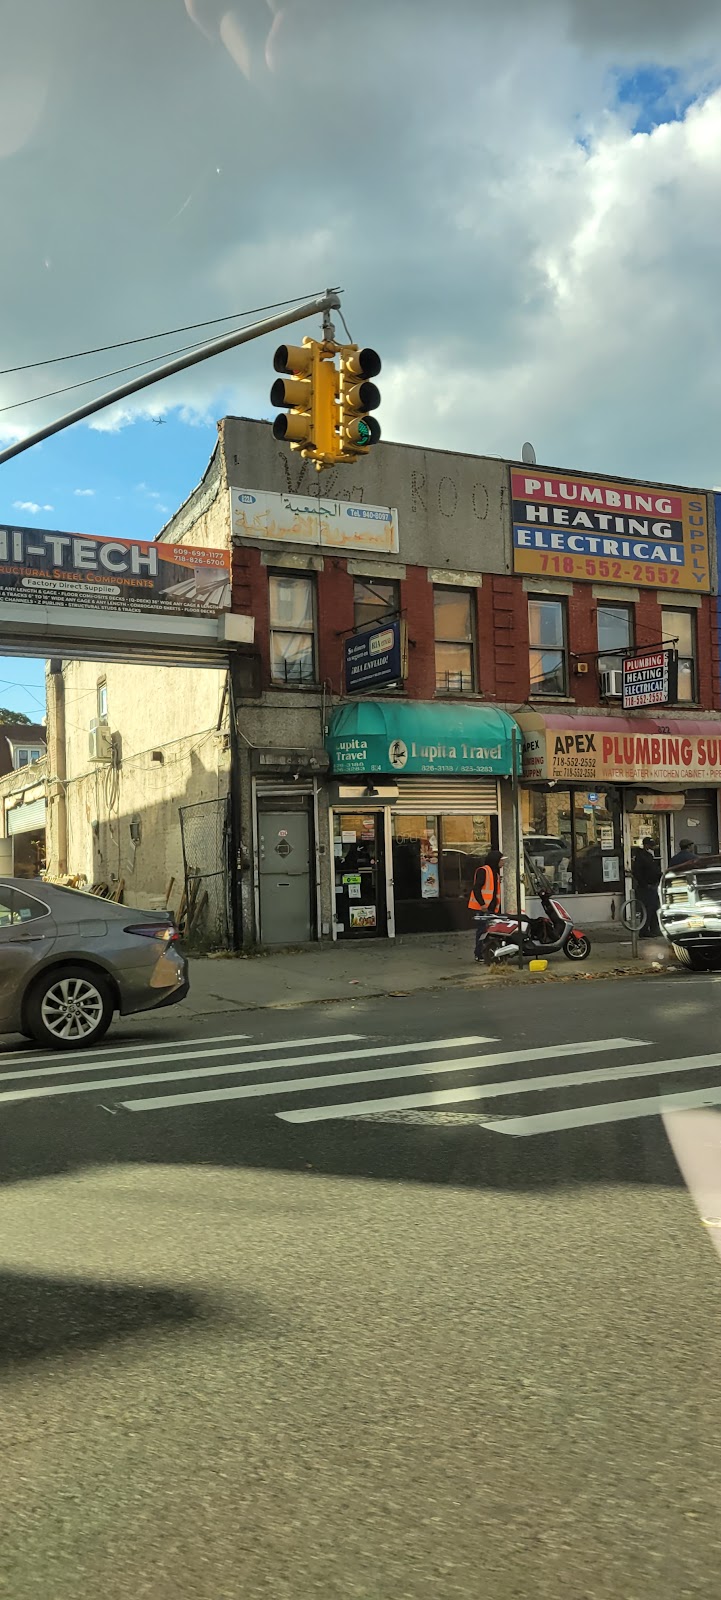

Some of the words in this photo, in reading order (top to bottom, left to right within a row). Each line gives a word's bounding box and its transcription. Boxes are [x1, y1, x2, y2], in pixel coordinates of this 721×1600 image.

[524, 478, 673, 514] PLUMBING
[525, 504, 673, 538] HEATING
[516, 529, 682, 563] ELECTRICAL
[688, 501, 707, 583] SUPPLY
[173, 548, 224, 559] 609-699-1177
[173, 555, 225, 566] 718-826-6700
[539, 554, 680, 585] 718-552-2552
[27, 579, 57, 588] Factory
[59, 582, 82, 590] Direct
[84, 584, 115, 592] Supplier
[53, 570, 83, 581] STEEL
[86, 572, 154, 588] COMPONENTS
[626, 655, 662, 670] PLUMBING
[626, 667, 662, 683] HEATING
[625, 680, 663, 696] ELECTRICAL
[625, 692, 663, 706] 718-552-2552
[461, 743, 502, 760] Travel
[554, 734, 597, 755] APEX
[602, 735, 693, 767] PLUMBING
[697, 738, 721, 767] SU
[336, 750, 367, 760] Travel
[553, 757, 596, 767] 718-552-2552
[602, 769, 625, 778] WATER
[625, 769, 649, 778] HEATER
[653, 769, 679, 778] KITCHEN
[681, 769, 706, 778] CABINET
